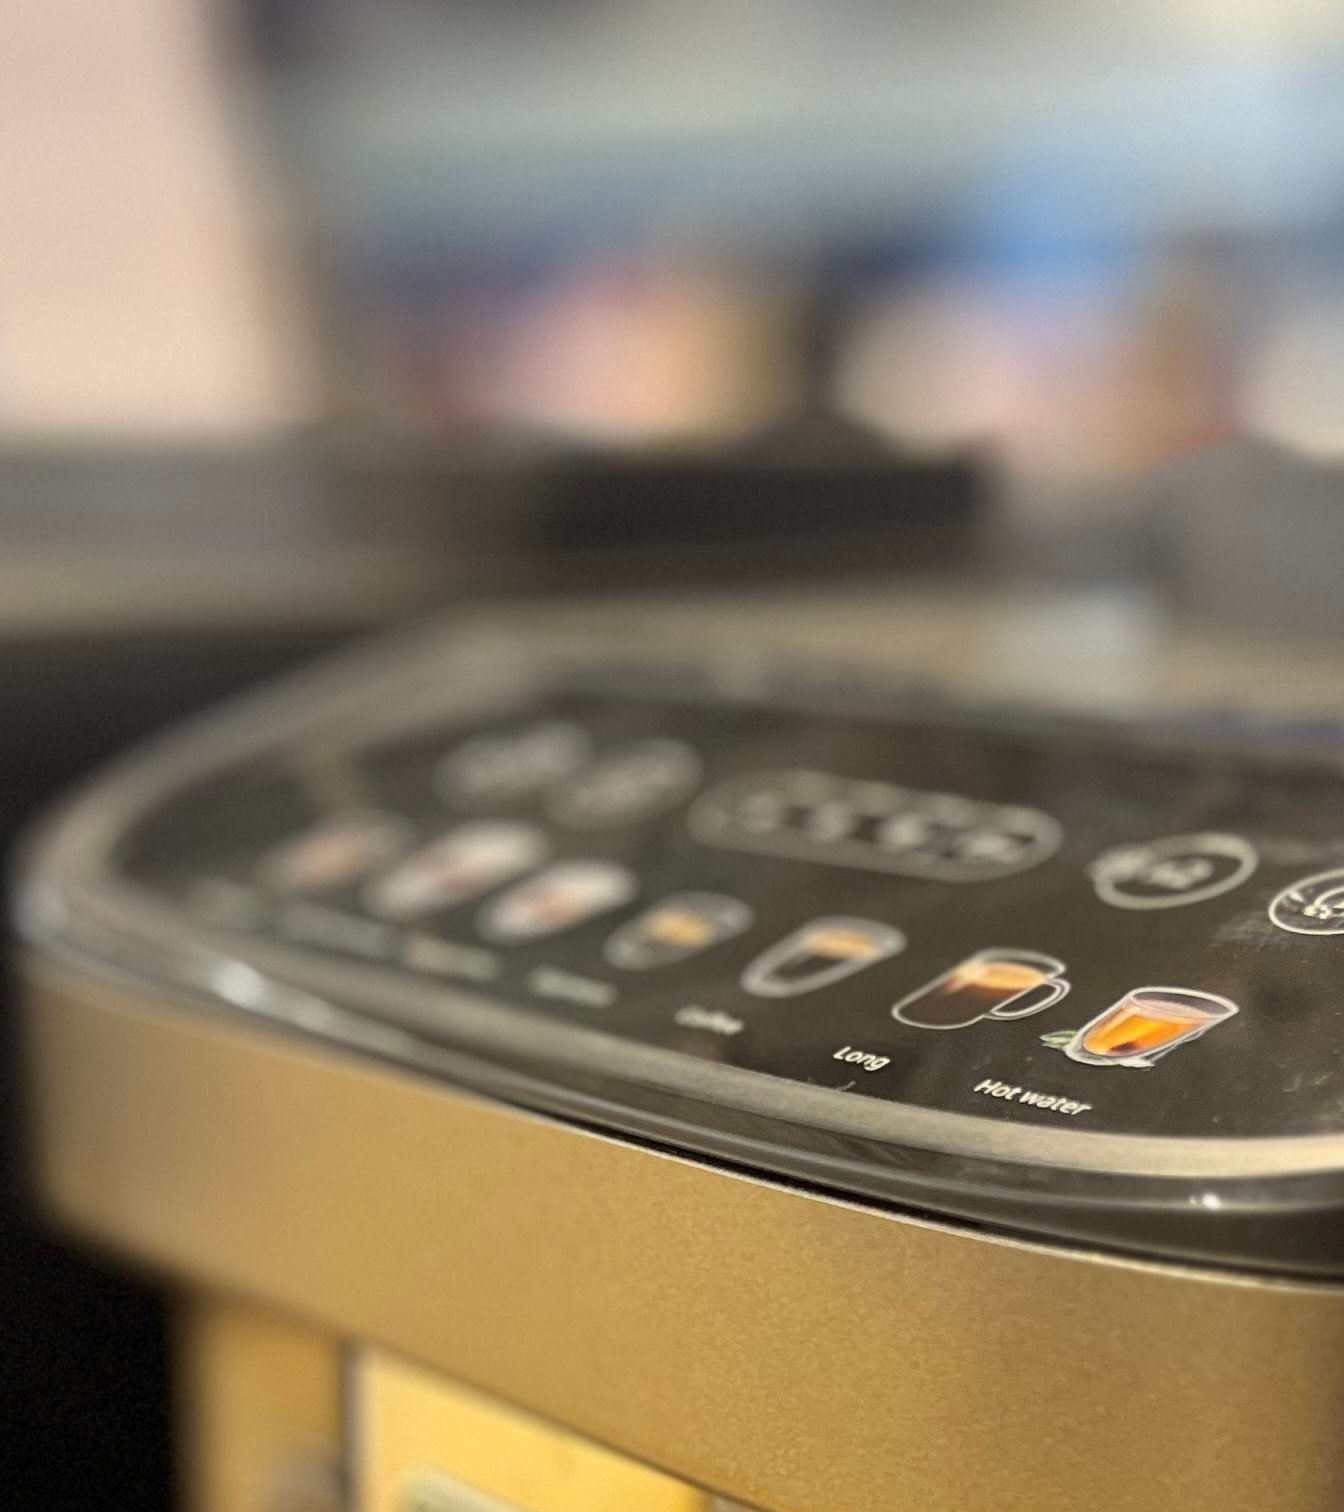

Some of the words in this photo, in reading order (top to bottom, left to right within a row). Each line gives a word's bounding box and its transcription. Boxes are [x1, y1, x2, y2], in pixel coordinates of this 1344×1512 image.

[832, 1045, 891, 1072] Long
[974, 1078, 1022, 1101] Hot
[1019, 1090, 1093, 1116] water
